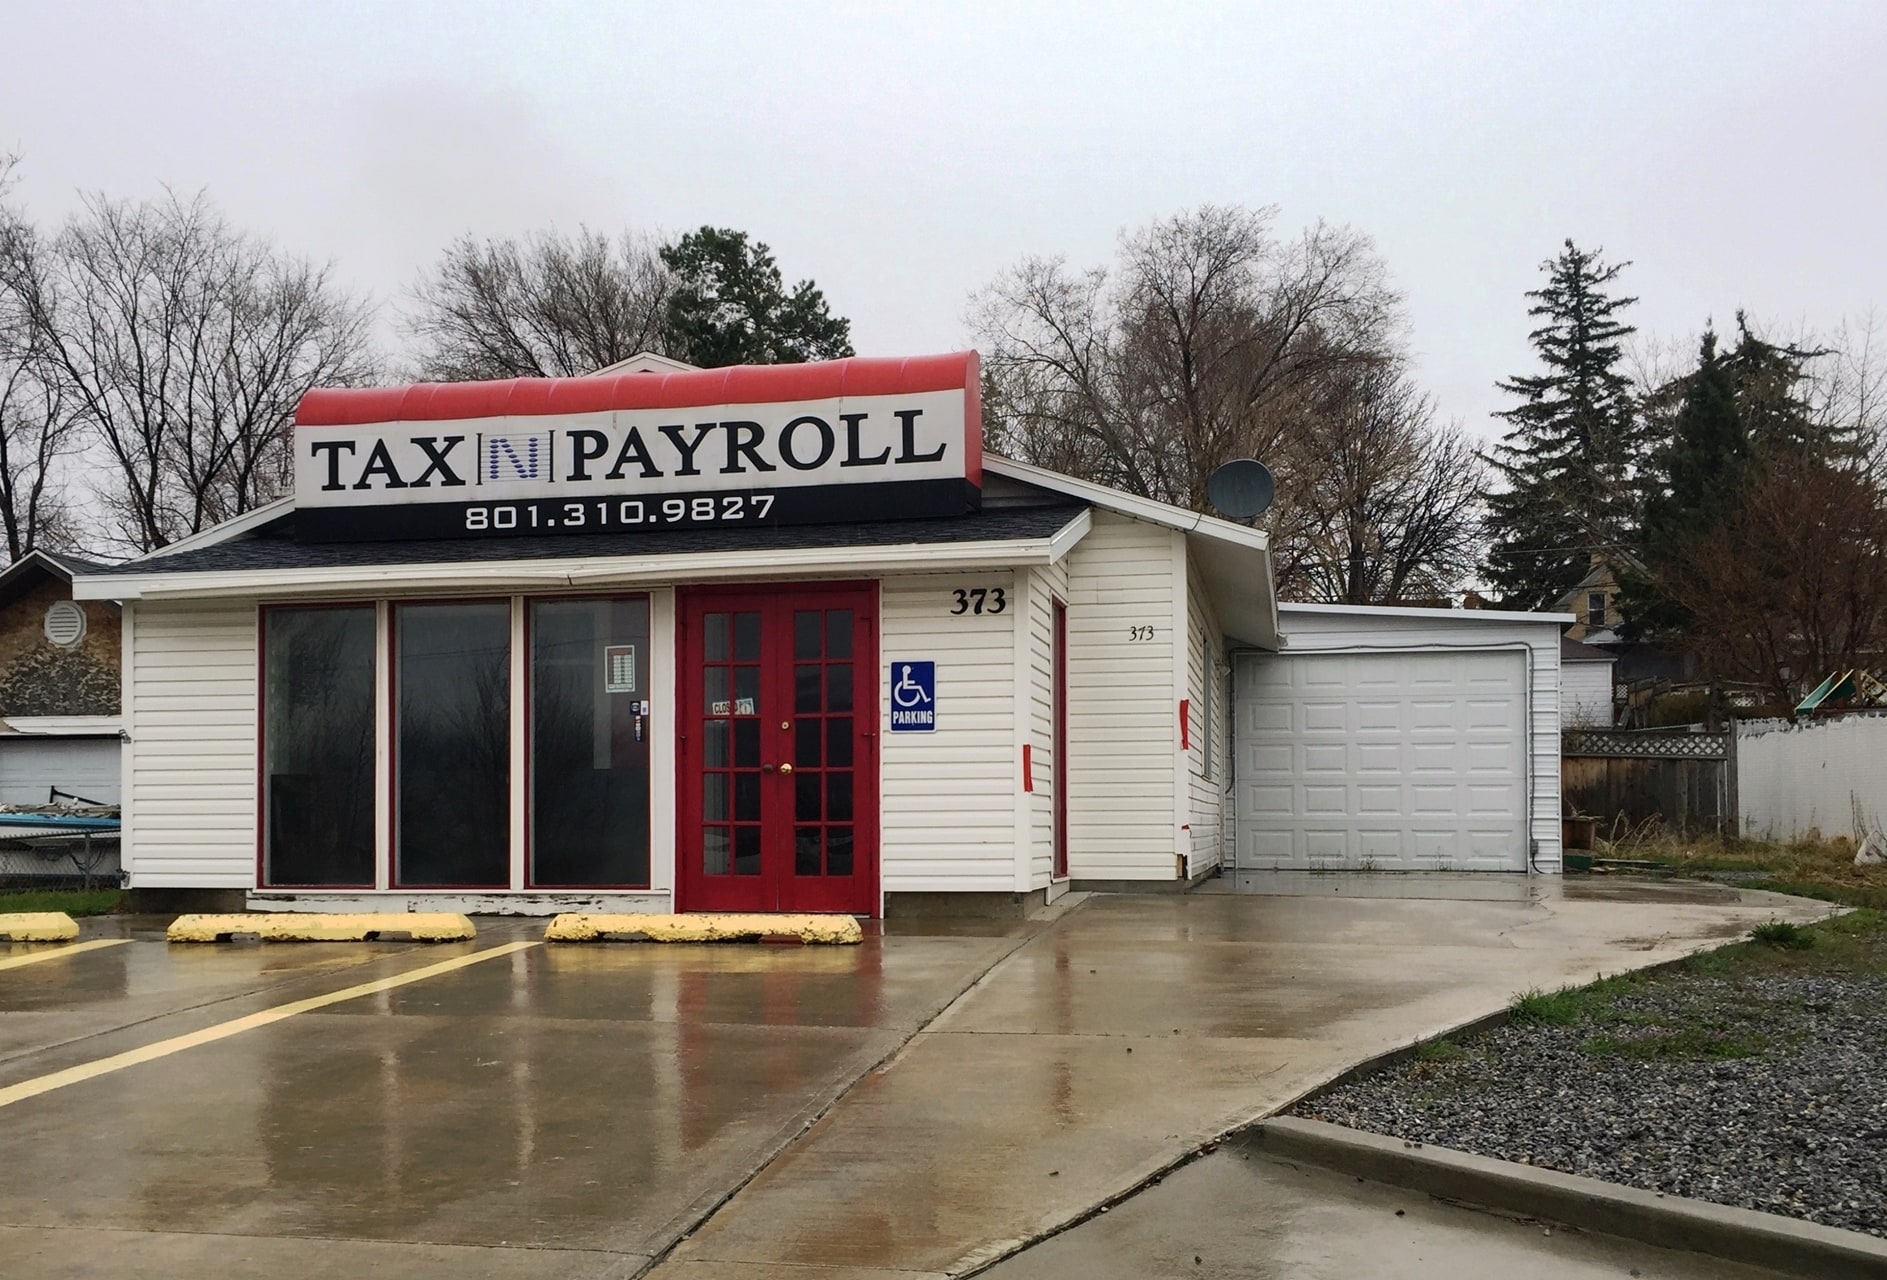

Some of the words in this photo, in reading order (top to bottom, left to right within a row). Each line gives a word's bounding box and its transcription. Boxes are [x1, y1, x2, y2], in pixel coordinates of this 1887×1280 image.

[311, 436, 467, 491] TAX
[489, 436, 539, 480] N
[565, 409, 947, 482] PAYROLL
[465, 495, 776, 530] 801.310.9827
[950, 588, 1007, 615] 373
[1128, 625, 1154, 642] 373
[714, 702, 739, 713] CLOSD
[892, 710, 933, 724] PARKING
